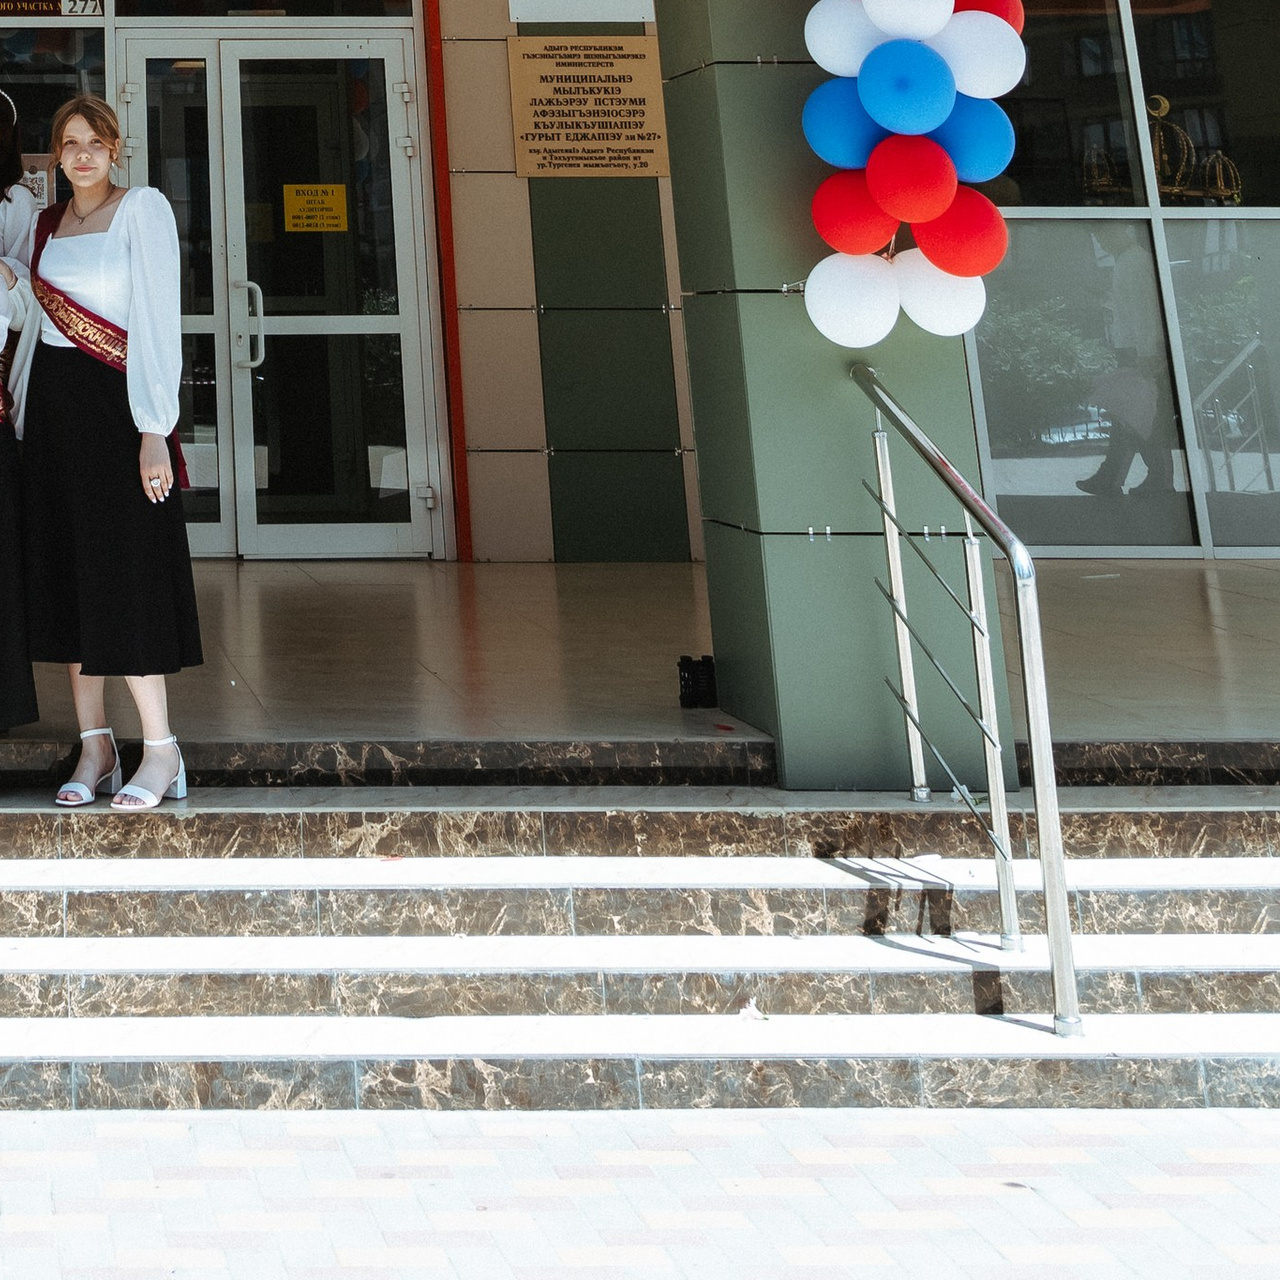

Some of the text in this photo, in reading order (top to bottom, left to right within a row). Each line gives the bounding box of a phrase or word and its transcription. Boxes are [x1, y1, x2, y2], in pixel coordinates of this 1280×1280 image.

[17, 1, 54, 11] УЧАСТКА
[540, 75, 633, 84] МУНИЦИПАЛЬНЭ
[594, 98, 646, 106] ПСТЭУМИ
[520, 132, 562, 141] «ГУРЫТ
[295, 189, 318, 197] ВХОД
